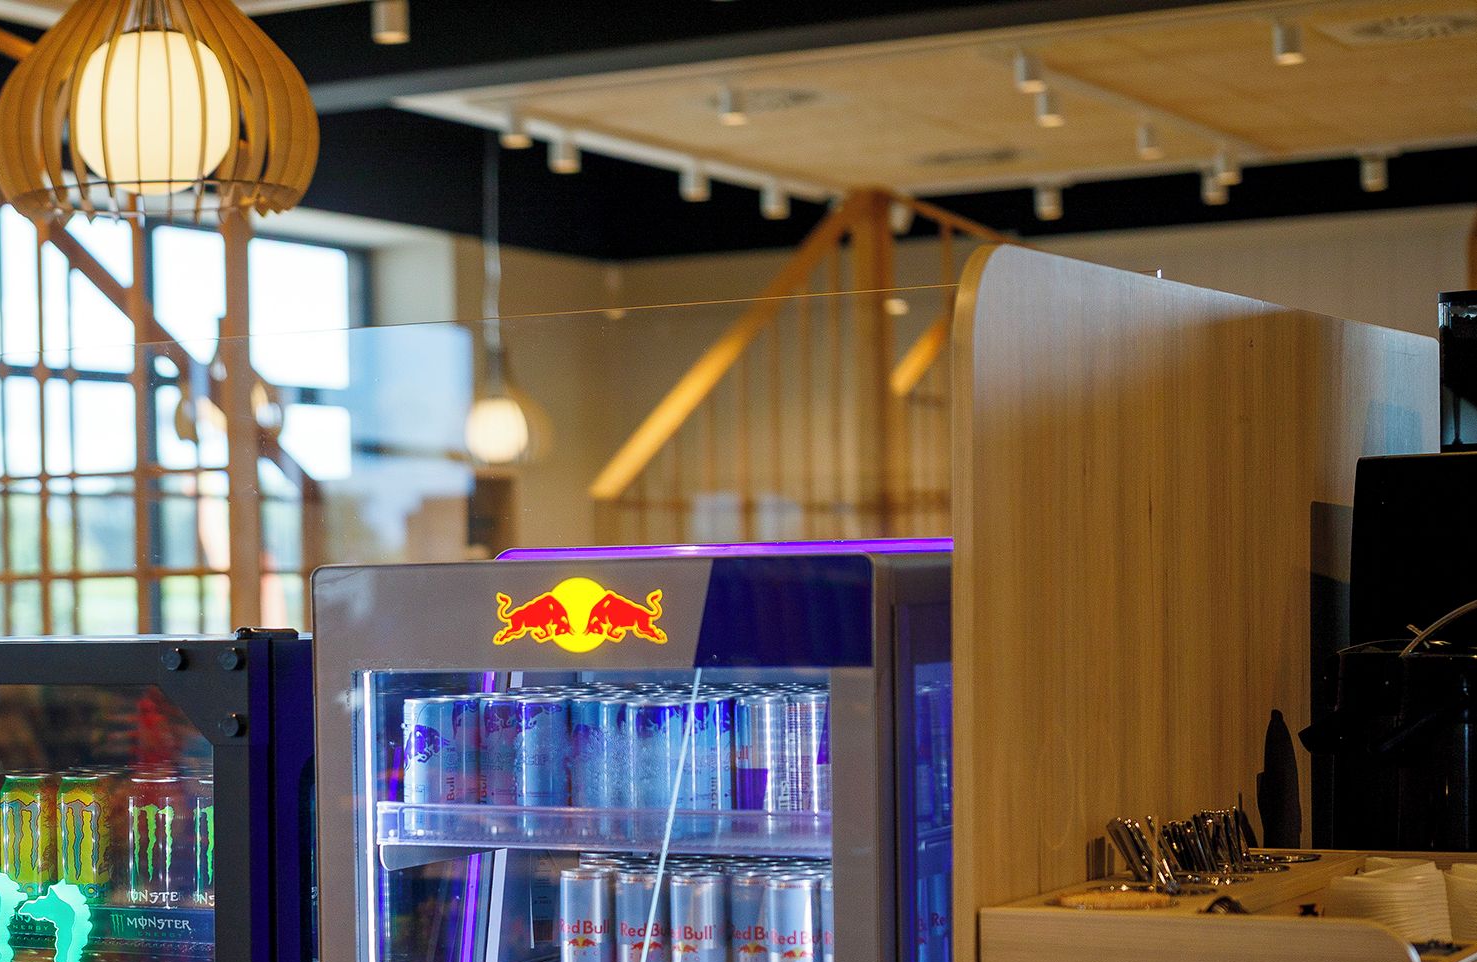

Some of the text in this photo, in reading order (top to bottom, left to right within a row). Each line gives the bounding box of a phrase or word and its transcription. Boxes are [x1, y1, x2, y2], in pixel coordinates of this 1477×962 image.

[126, 916, 192, 932] MONSTER
[583, 920, 610, 935] Bull
[620, 922, 646, 937] Red
[683, 925, 713, 941] Bull
